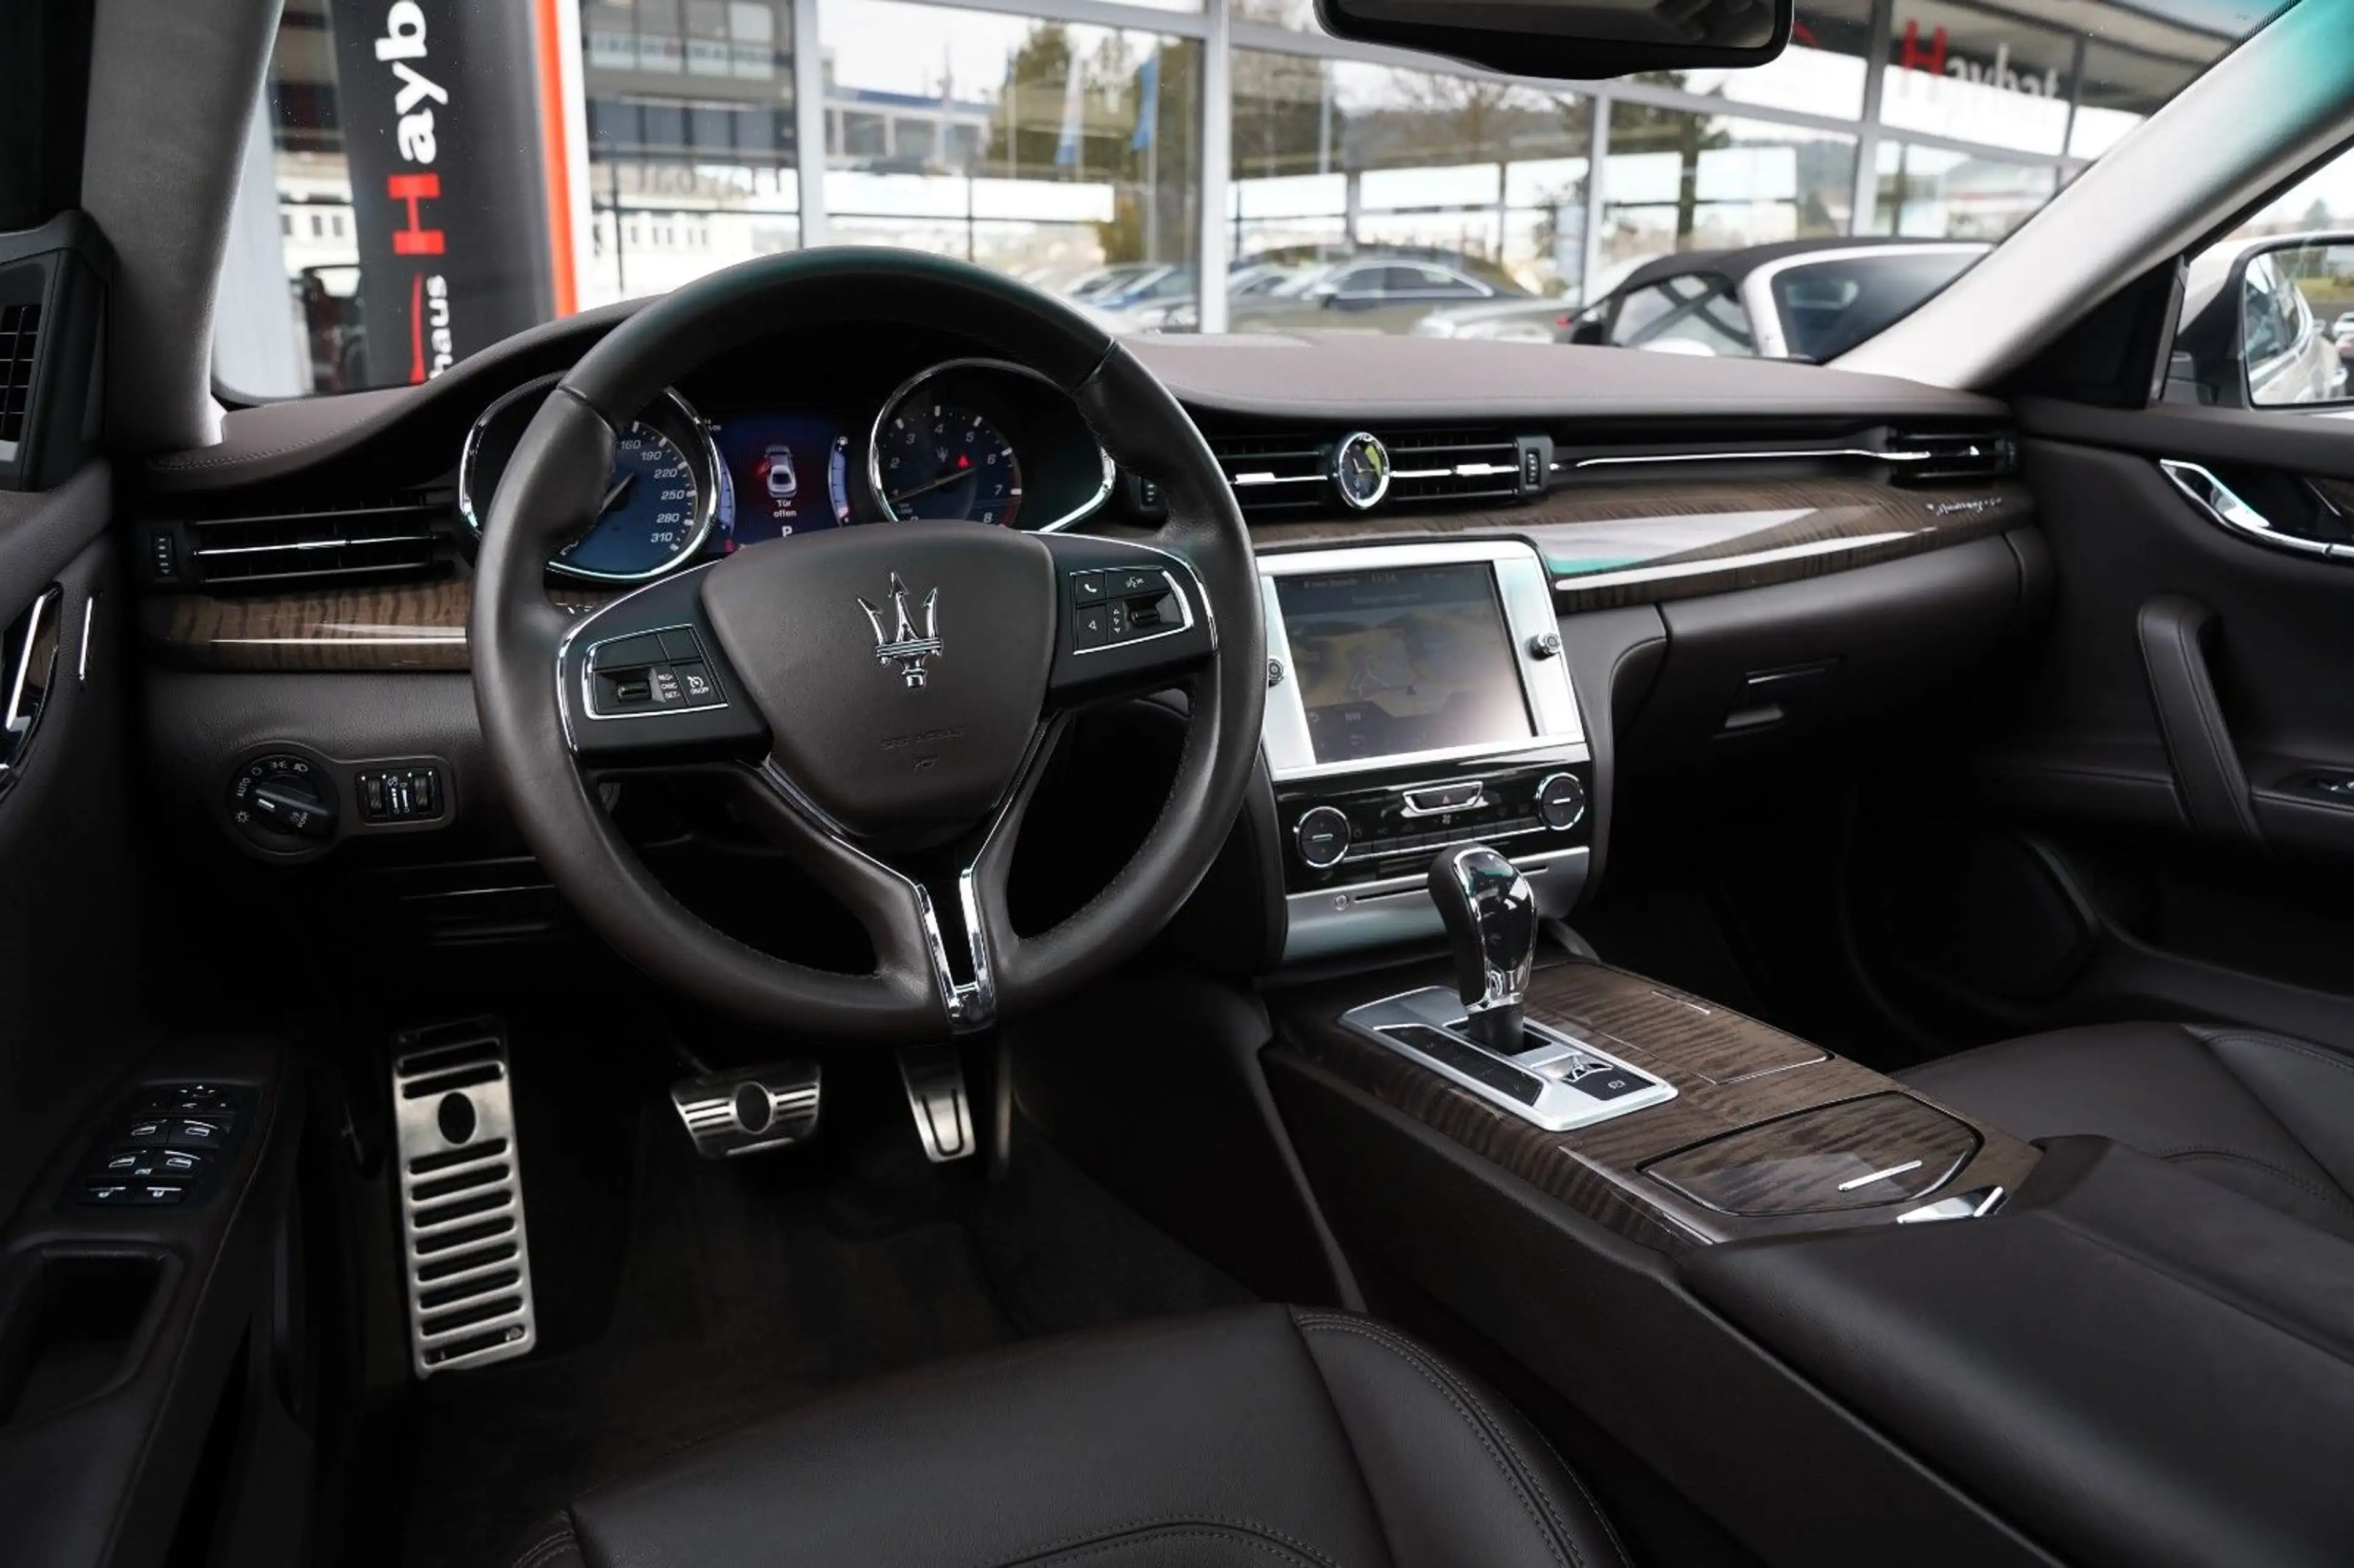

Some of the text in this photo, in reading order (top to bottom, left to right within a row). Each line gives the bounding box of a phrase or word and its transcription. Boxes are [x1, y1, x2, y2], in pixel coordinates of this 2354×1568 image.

[934, 424, 944, 433] 4
[905, 433, 916, 444] 3
[966, 432, 975, 442] 5
[620, 440, 641, 450] 160
[642, 451, 662, 460] 190
[987, 454, 996, 465] 6
[889, 457, 901, 468] 2
[654, 468, 677, 478] 220
[993, 484, 1004, 495] 7
[661, 490, 685, 500] 250
[656, 513, 680, 523] 280
[984, 512, 993, 523] 8
[782, 525, 793, 536] P
[650, 533, 673, 542] 310
[236, 777, 251, 797] AUTO
